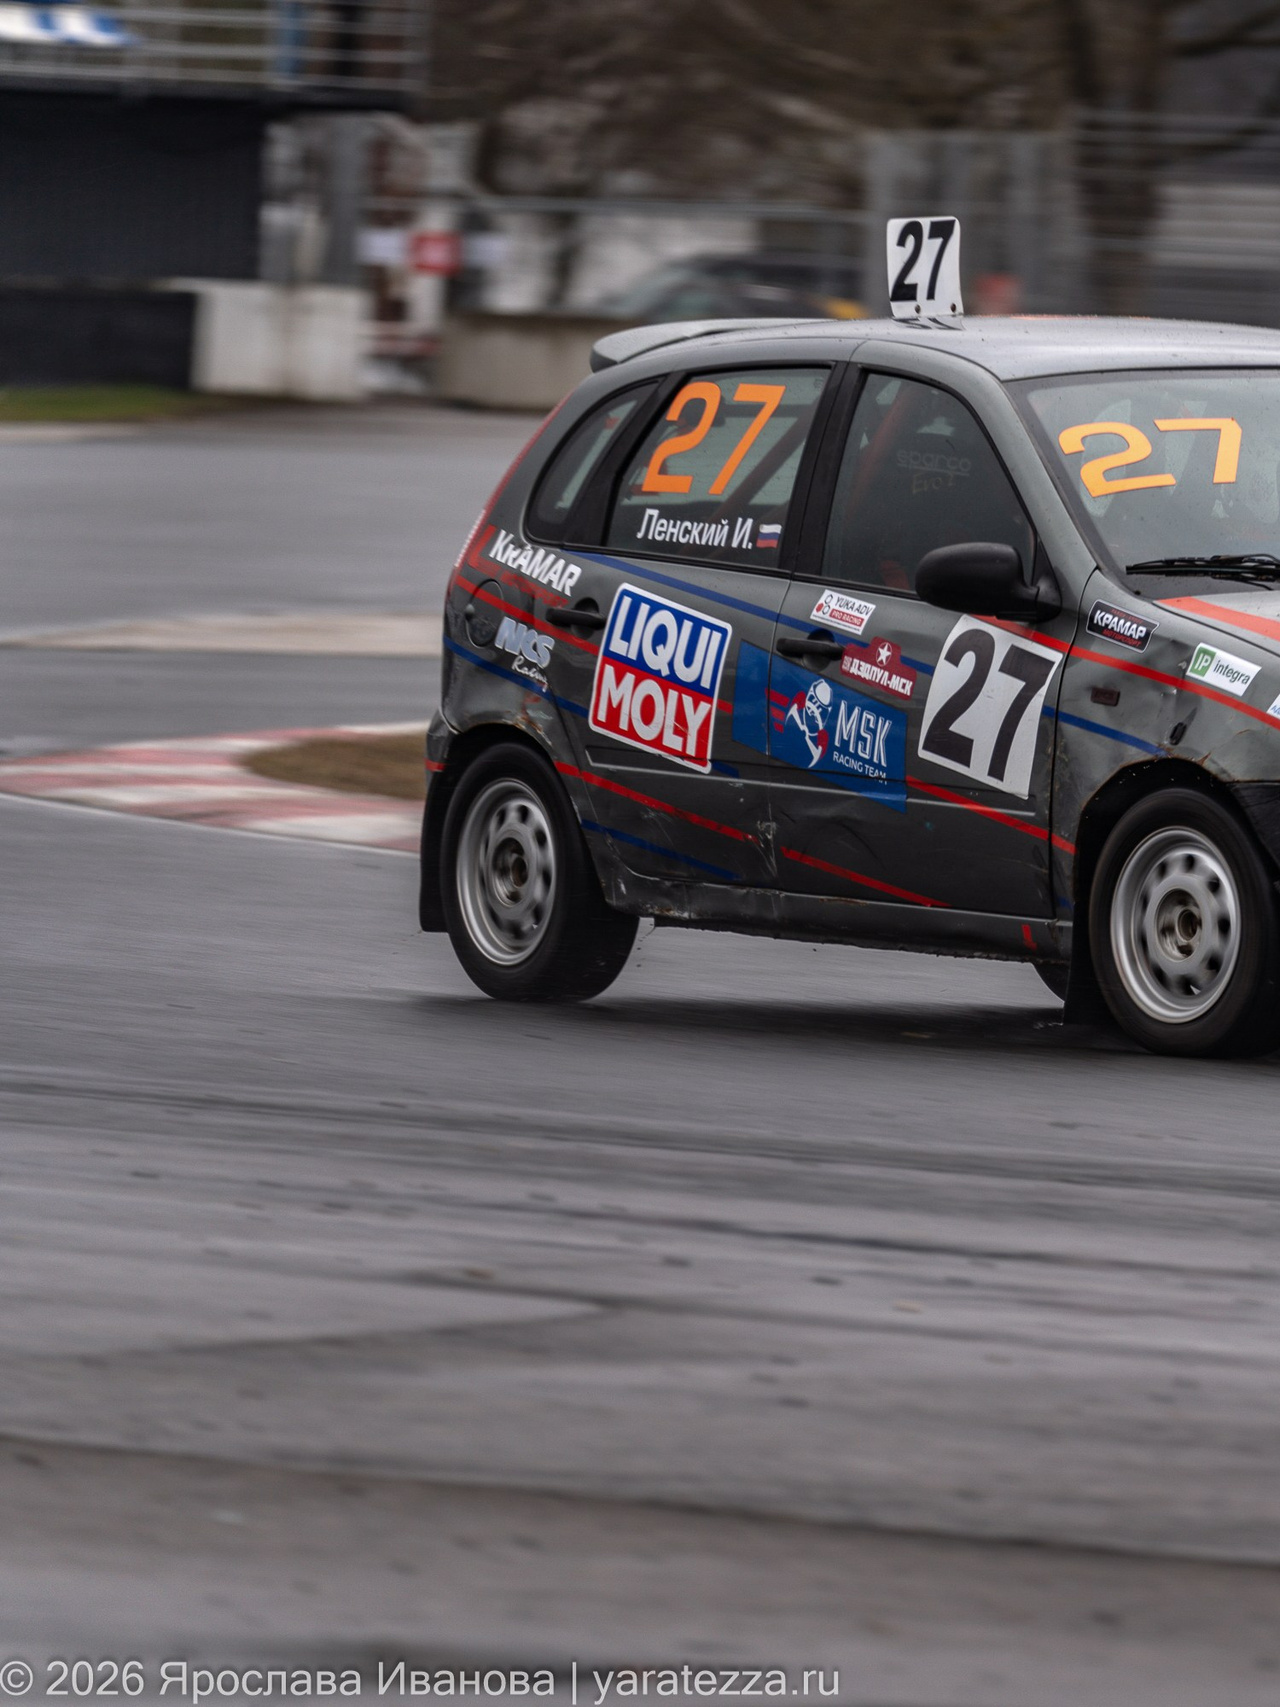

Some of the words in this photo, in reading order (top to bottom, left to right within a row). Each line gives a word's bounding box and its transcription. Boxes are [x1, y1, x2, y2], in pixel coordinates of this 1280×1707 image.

[890, 220, 956, 302] 27
[641, 381, 786, 495] 27
[896, 450, 972, 473] sparco
[1058, 417, 1243, 498] 27
[489, 529, 582, 597] KRAMAR
[636, 508, 730, 548] Ленский
[732, 517, 754, 550] И.
[834, 596, 855, 612] YUKA
[854, 604, 873, 616] ADV
[1093, 609, 1147, 640] КРАМАР
[609, 595, 723, 689] LIQUI
[1193, 652, 1212, 670] IP
[1213, 660, 1251, 685] integra
[597, 664, 711, 756] MOLY
[834, 700, 892, 768] MSK
[922, 628, 1056, 783] 27
[833, 751, 864, 773] RACING
